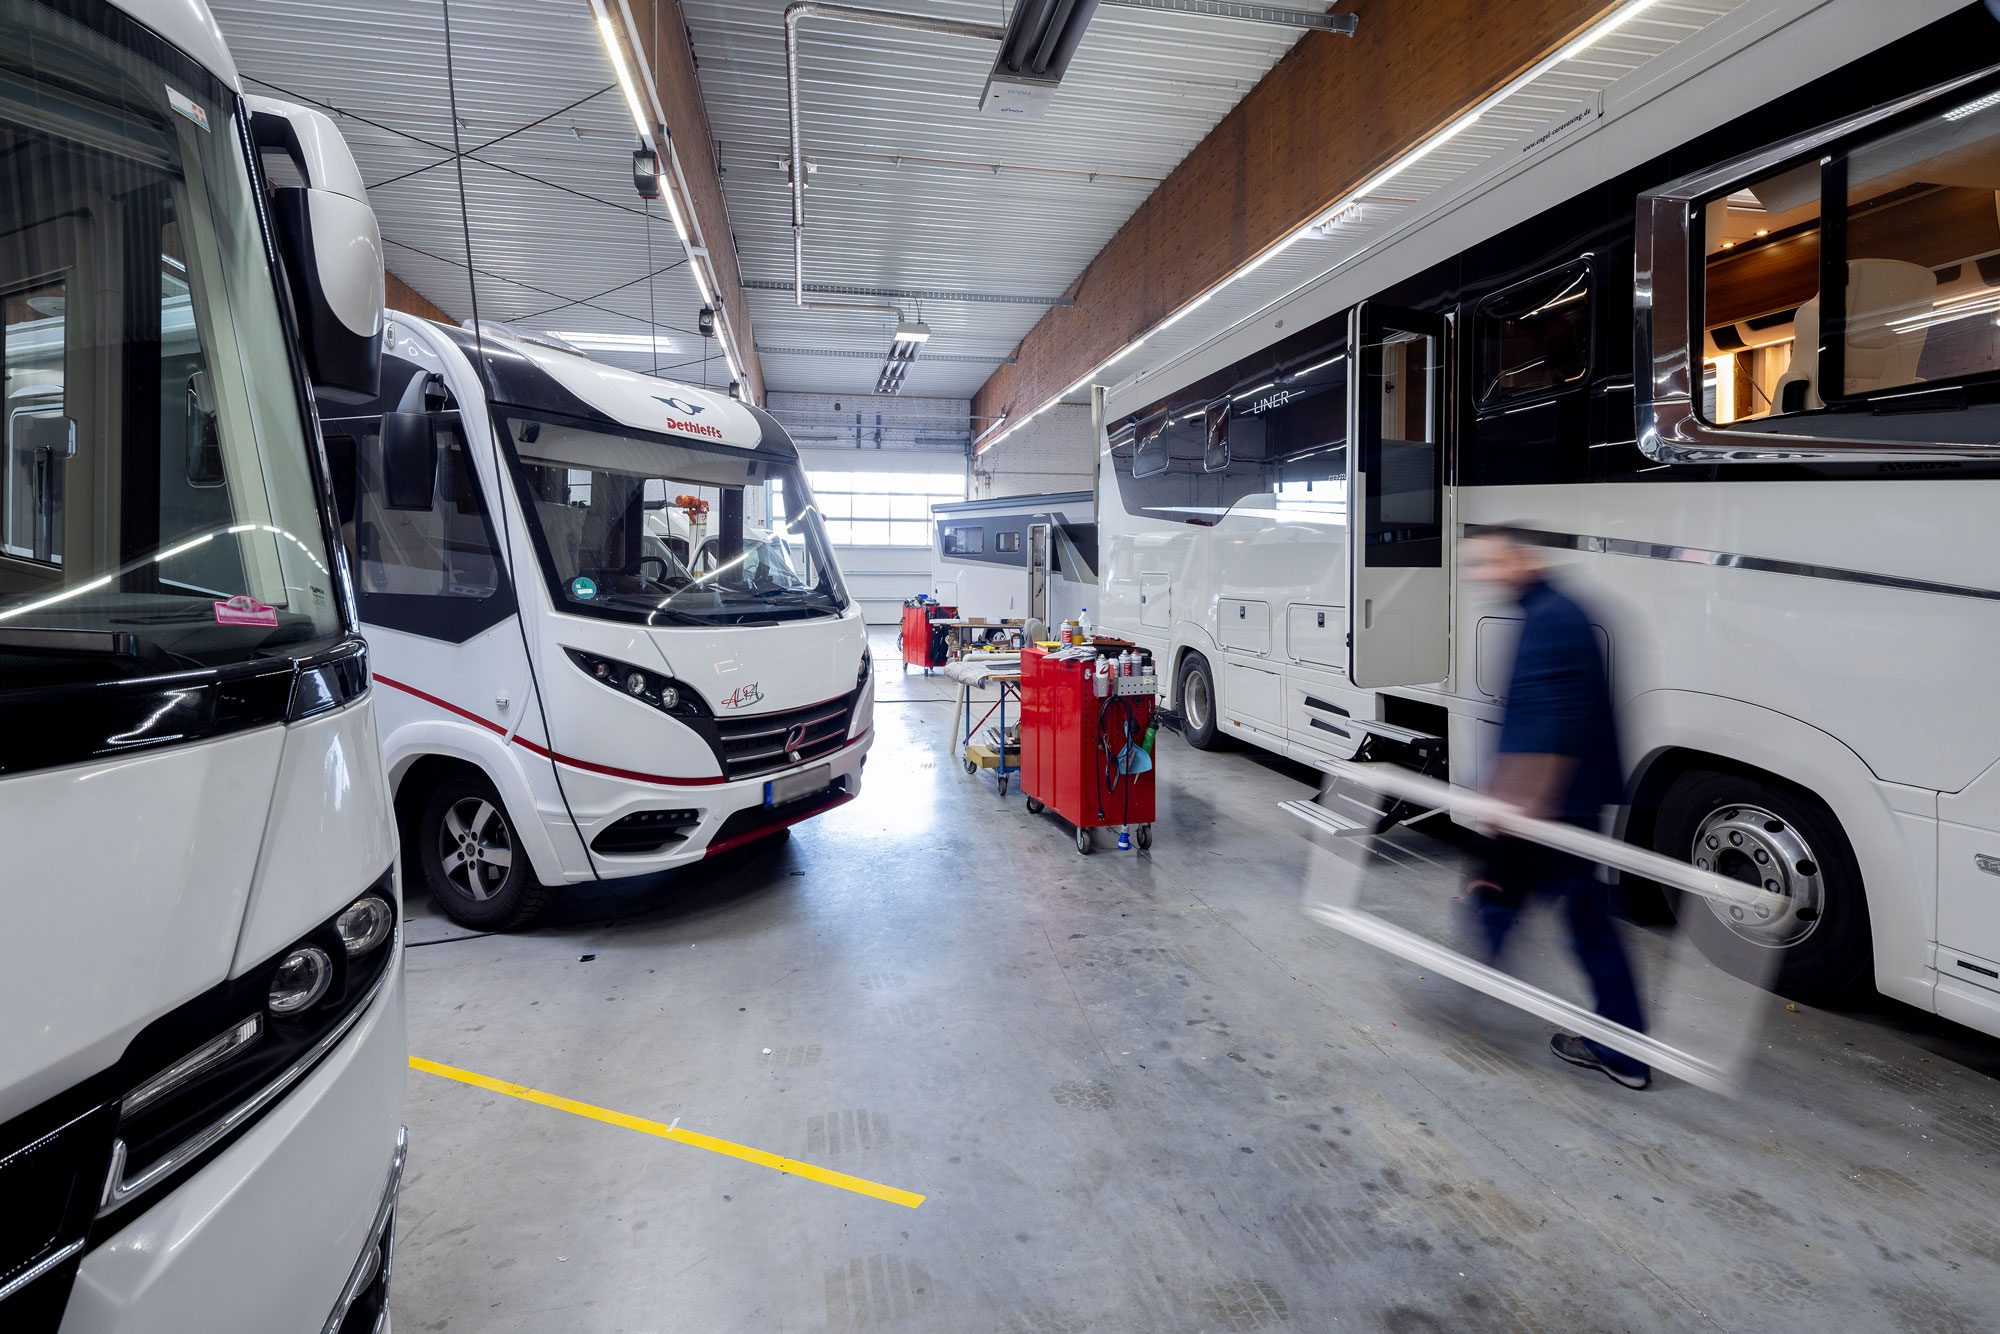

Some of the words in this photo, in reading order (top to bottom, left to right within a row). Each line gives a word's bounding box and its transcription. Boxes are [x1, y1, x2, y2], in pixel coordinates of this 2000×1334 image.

[1522, 108, 1591, 153] www.engel-caravaning.de
[1254, 391, 1289, 414] LINER
[666, 417, 723, 439] Dethleffs
